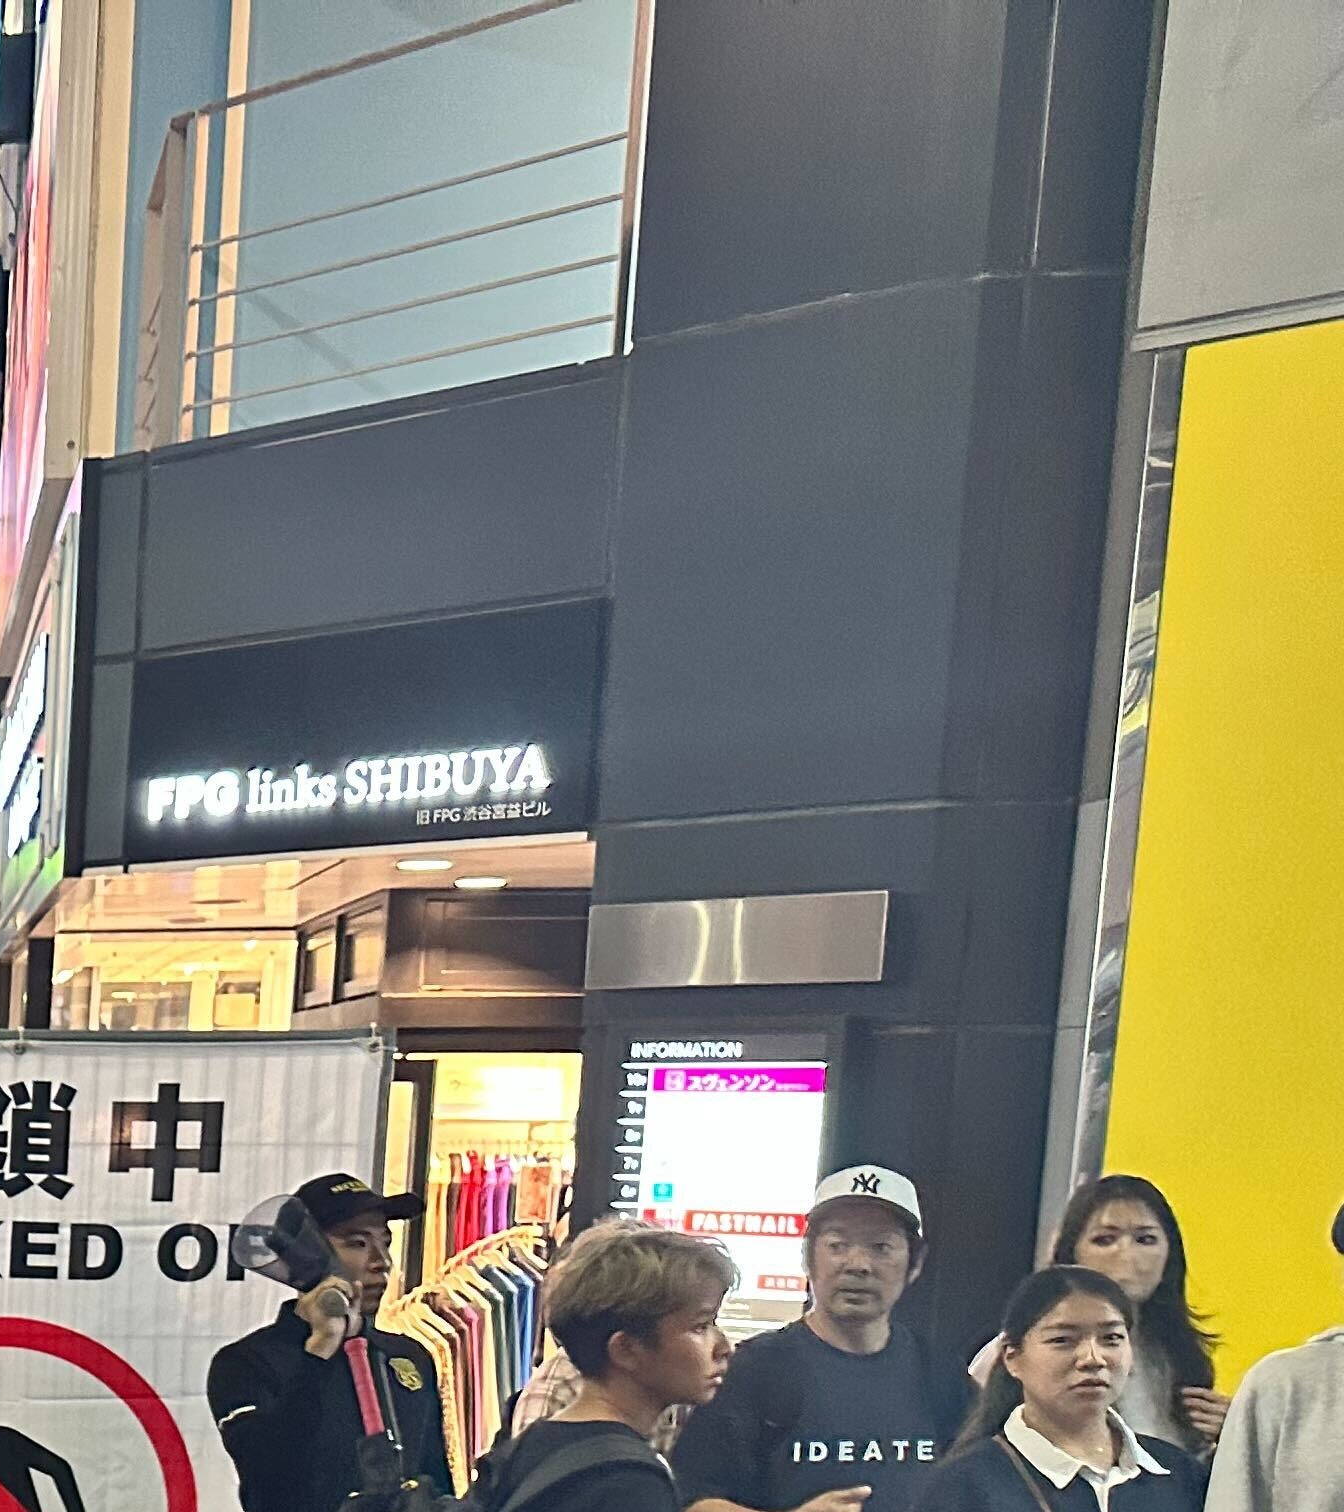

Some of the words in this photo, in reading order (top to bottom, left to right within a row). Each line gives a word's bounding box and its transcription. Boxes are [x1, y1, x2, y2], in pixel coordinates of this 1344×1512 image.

[148, 769, 241, 823] FPG
[246, 761, 338, 812] links
[343, 743, 552, 806] SHIBUYA
[433, 806, 462, 824] FPG
[630, 1041, 744, 1059] INFORMATION
[792, 1440, 935, 1463] IDEATE
